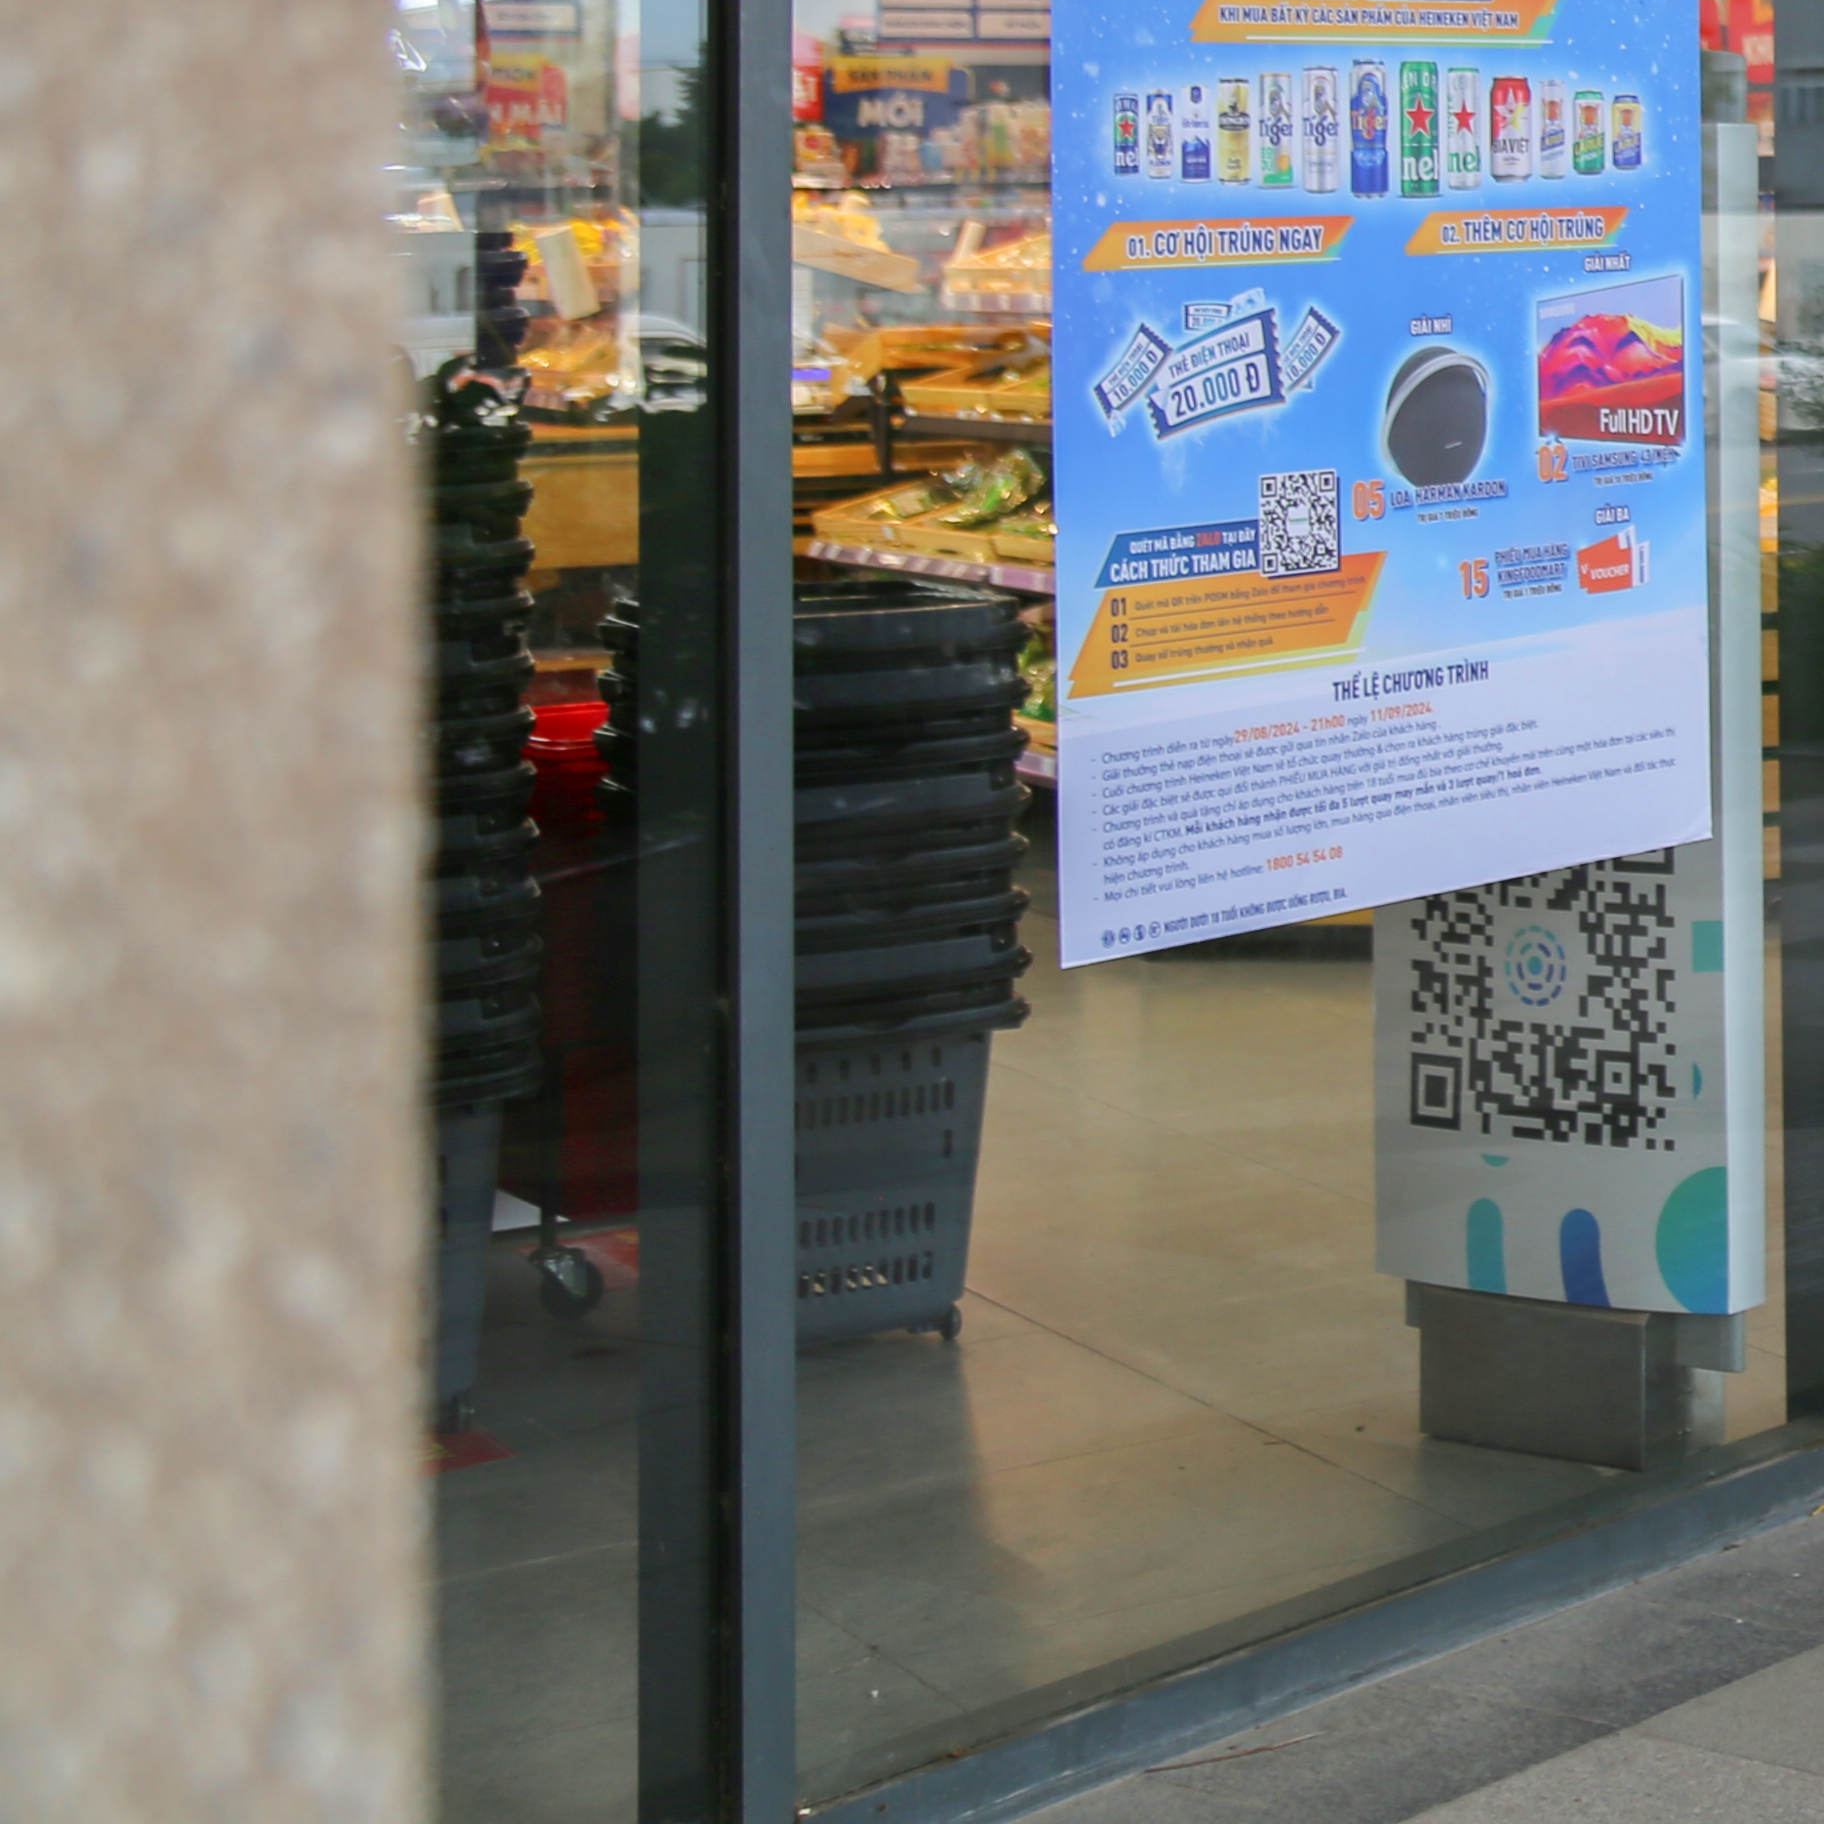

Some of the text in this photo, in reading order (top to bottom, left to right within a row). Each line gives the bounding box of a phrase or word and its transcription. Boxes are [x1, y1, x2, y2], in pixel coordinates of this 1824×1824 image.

[1242, 6, 1268, 24] MUA
[1418, 9, 1469, 28] HEINEKEN
[1127, 223, 1324, 260] 01. CƠ HỘI TRÚNG NGAY
[1463, 216, 1502, 244] THÊM
[1505, 218, 1529, 242] CƠ
[1531, 215, 1554, 246] HỘI
[1558, 212, 1604, 239] TRÚNG
[1169, 357, 1189, 378] THẺ
[1217, 332, 1250, 355] THOẠI
[1171, 362, 1260, 419] 20.000 Đ
[1653, 409, 1680, 435] TV
[1537, 445, 1569, 482] 02
[1351, 479, 1385, 521] 05
[1414, 482, 1461, 505] HARMAN
[1462, 479, 1507, 501] KARDON
[1110, 549, 1257, 583] CÁCH THỨC THAM GIA
[1332, 656, 1489, 702] THỂ LỆ CHƯƠNG TRÌNH
[1234, 722, 1300, 744] 29/08/2024
[1310, 714, 1346, 732] 21h00
[1266, 854, 1293, 872] 1800
[1295, 851, 1311, 867] 54
[1313, 848, 1327, 864] 54
